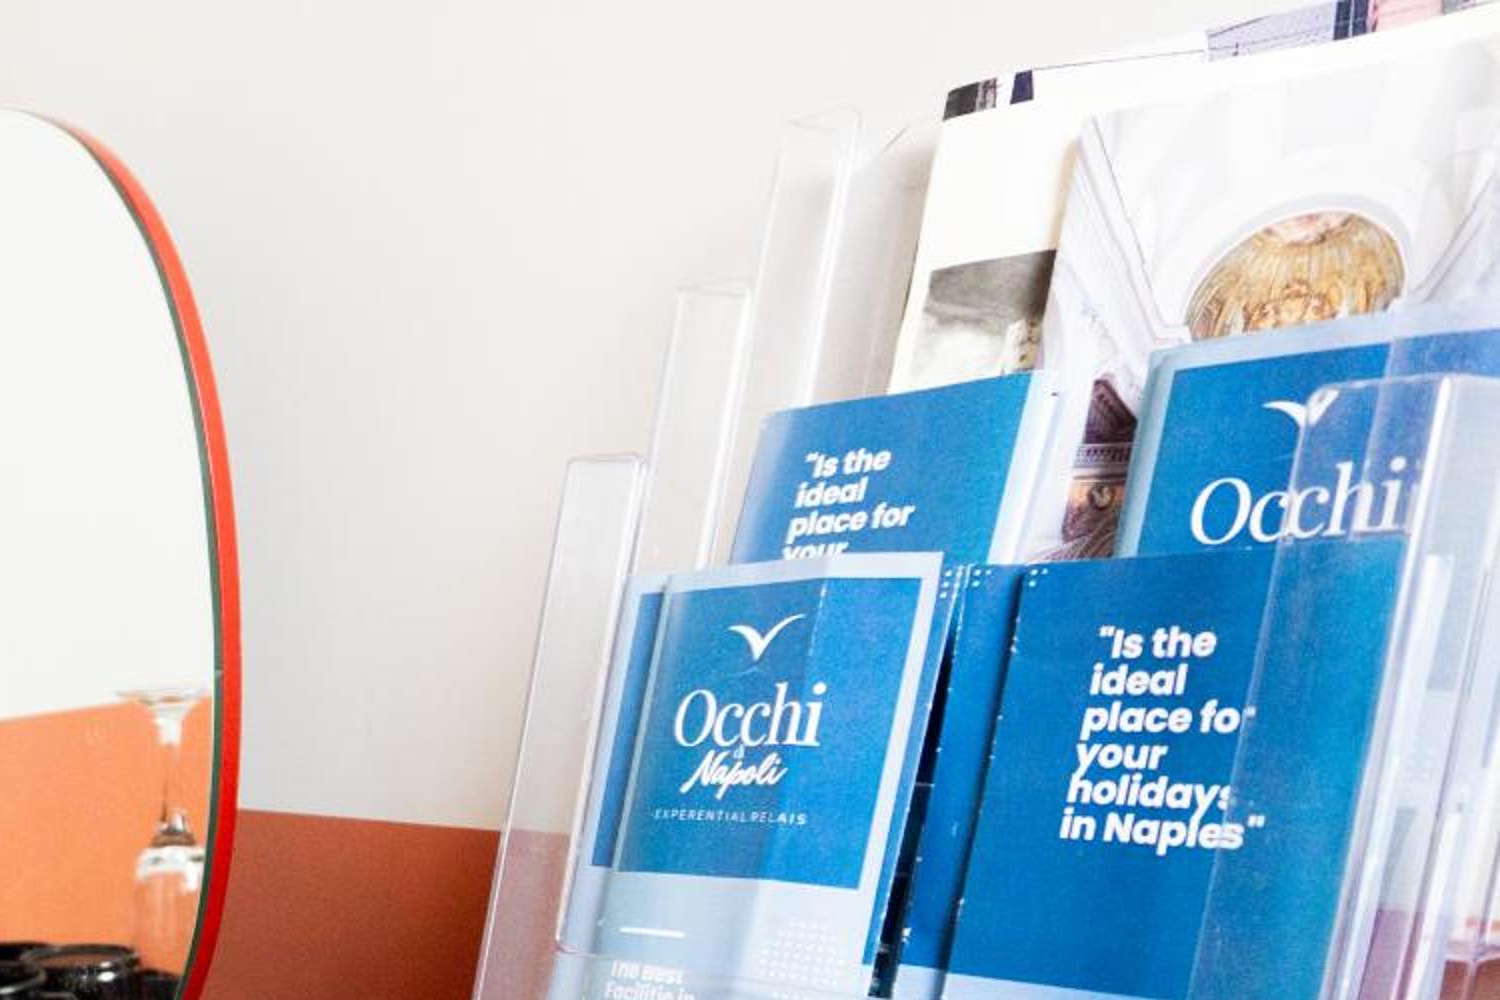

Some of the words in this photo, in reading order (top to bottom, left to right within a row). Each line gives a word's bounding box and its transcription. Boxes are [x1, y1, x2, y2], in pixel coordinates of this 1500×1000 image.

[843, 448, 892, 474] the
[794, 476, 868, 508] ideal
[1190, 456, 1406, 545] Occhi
[786, 511, 868, 544] place
[871, 501, 916, 528] for
[1099, 625, 1144, 659] "Is
[1152, 625, 1217, 658] the
[1089, 663, 1189, 696] ideal
[674, 681, 828, 747] Occhi
[1079, 700, 1192, 741] place
[680, 750, 788, 800] Napoli
[1076, 743, 1169, 778] your
[1059, 806, 1097, 841] in
